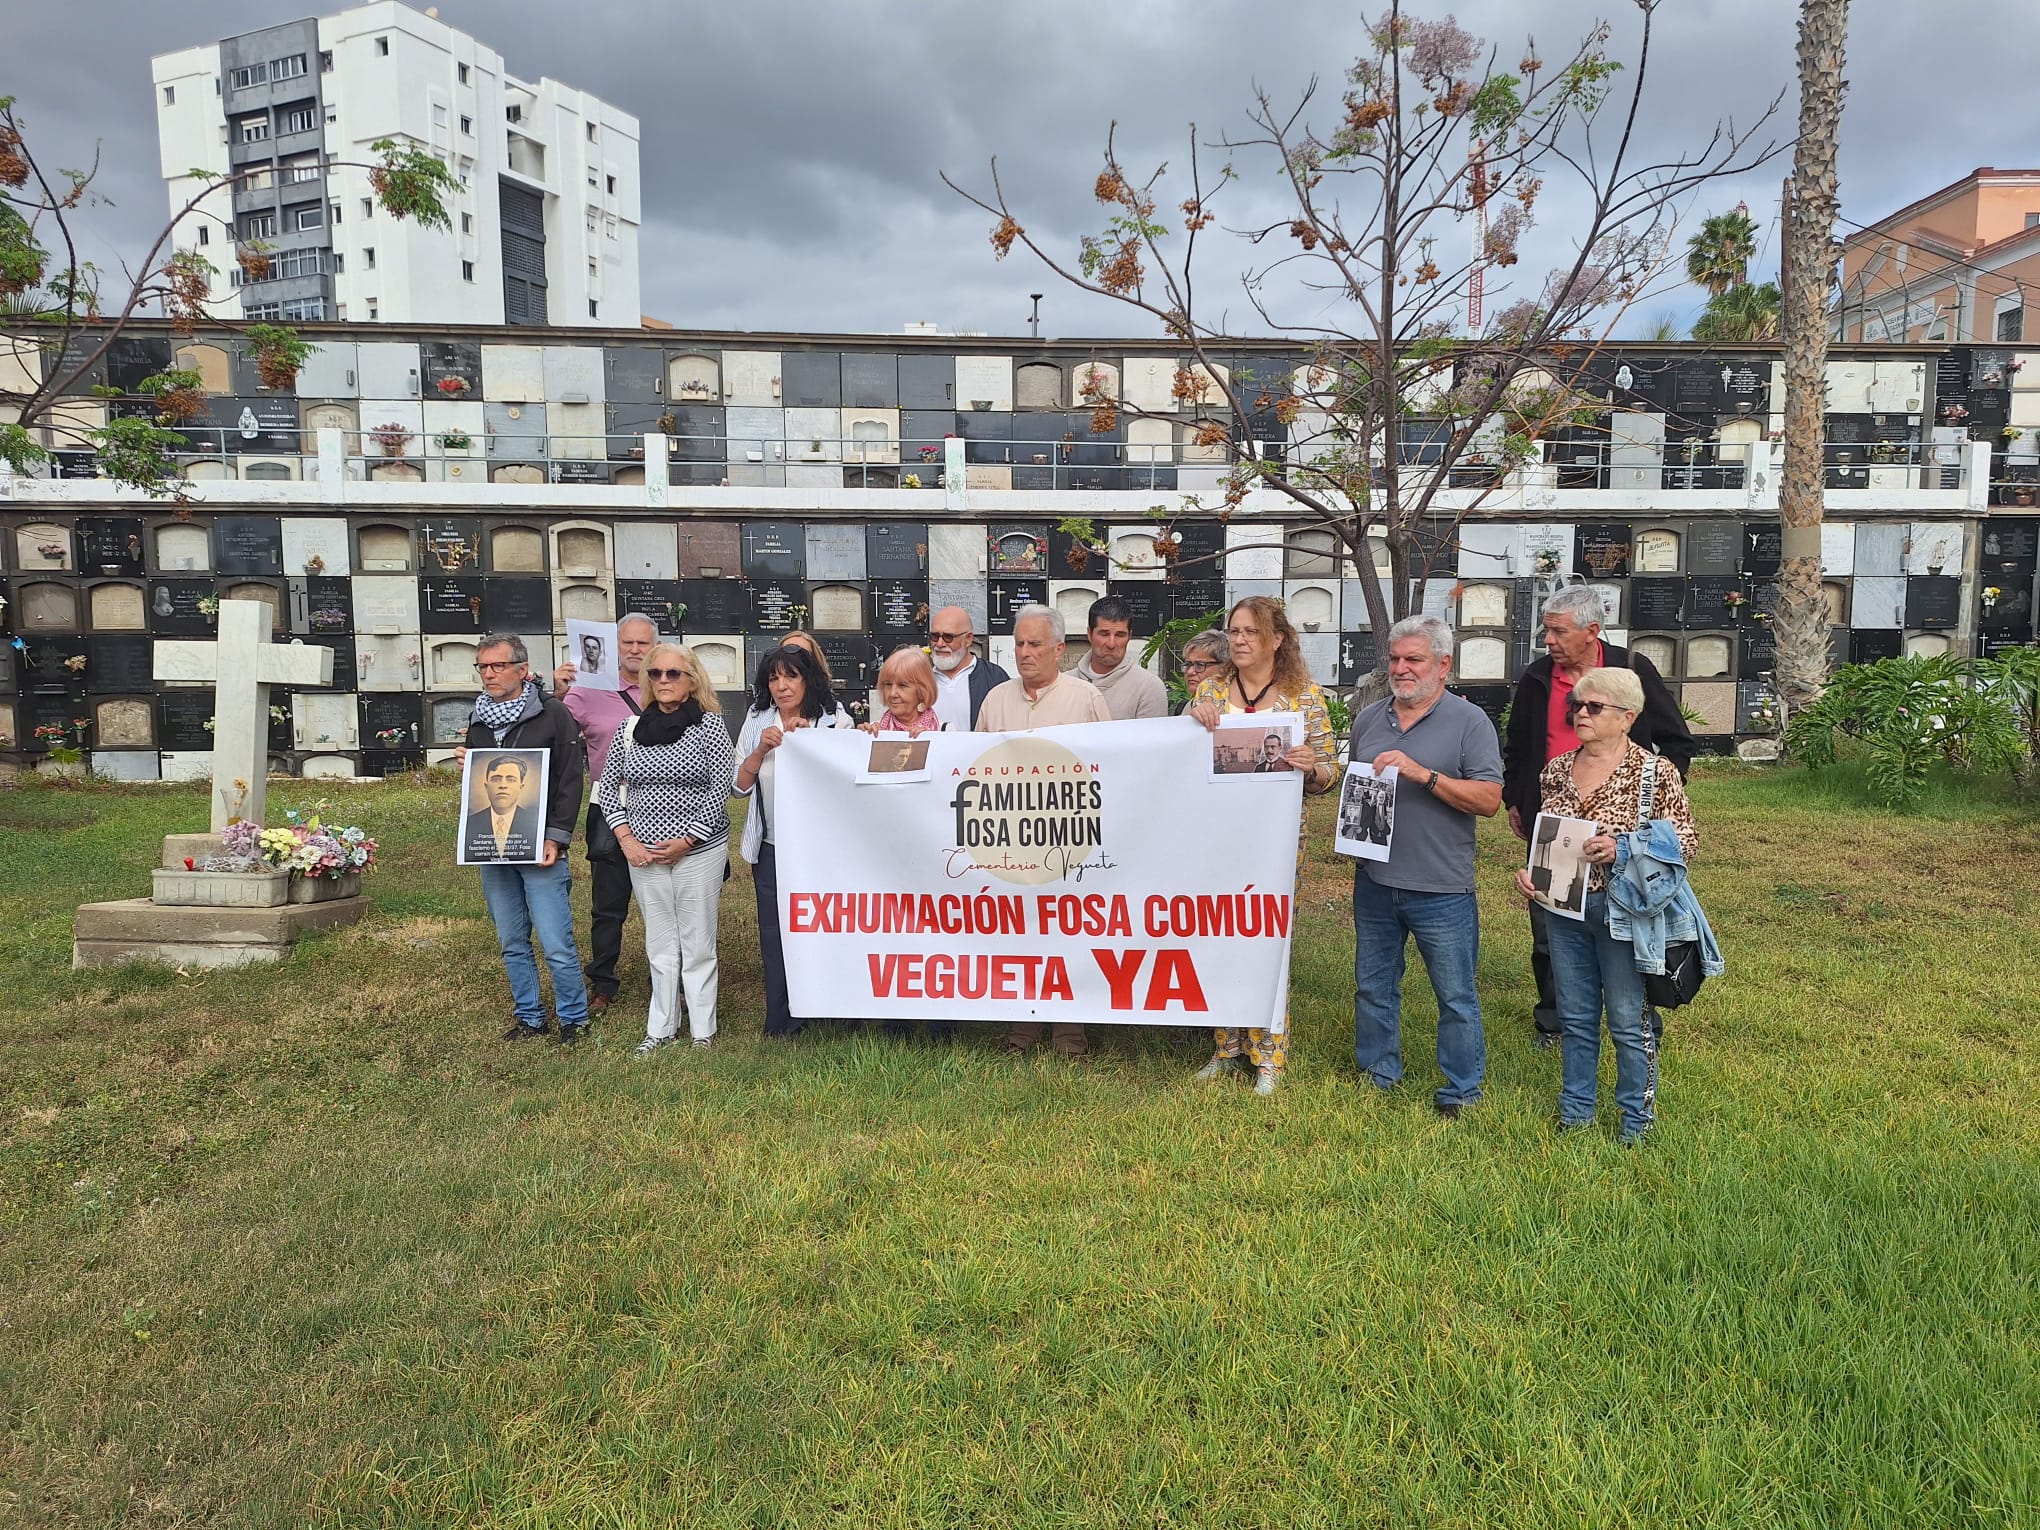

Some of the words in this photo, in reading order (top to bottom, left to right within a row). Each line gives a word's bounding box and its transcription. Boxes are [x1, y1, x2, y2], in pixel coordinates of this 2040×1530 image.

[951, 762, 1100, 777] AGRUPACIÓN
[1018, 810, 1102, 847] COMÚN
[942, 847, 1041, 879] Cementerio
[1043, 846, 1118, 882] Vegueta
[789, 885, 1026, 935] EXHUMACIÓN
[1038, 894, 1133, 938] FOSA
[1144, 884, 1289, 939] COMÚN
[867, 953, 1075, 1001] VEGUETA
[1091, 948, 1209, 1012] YA
